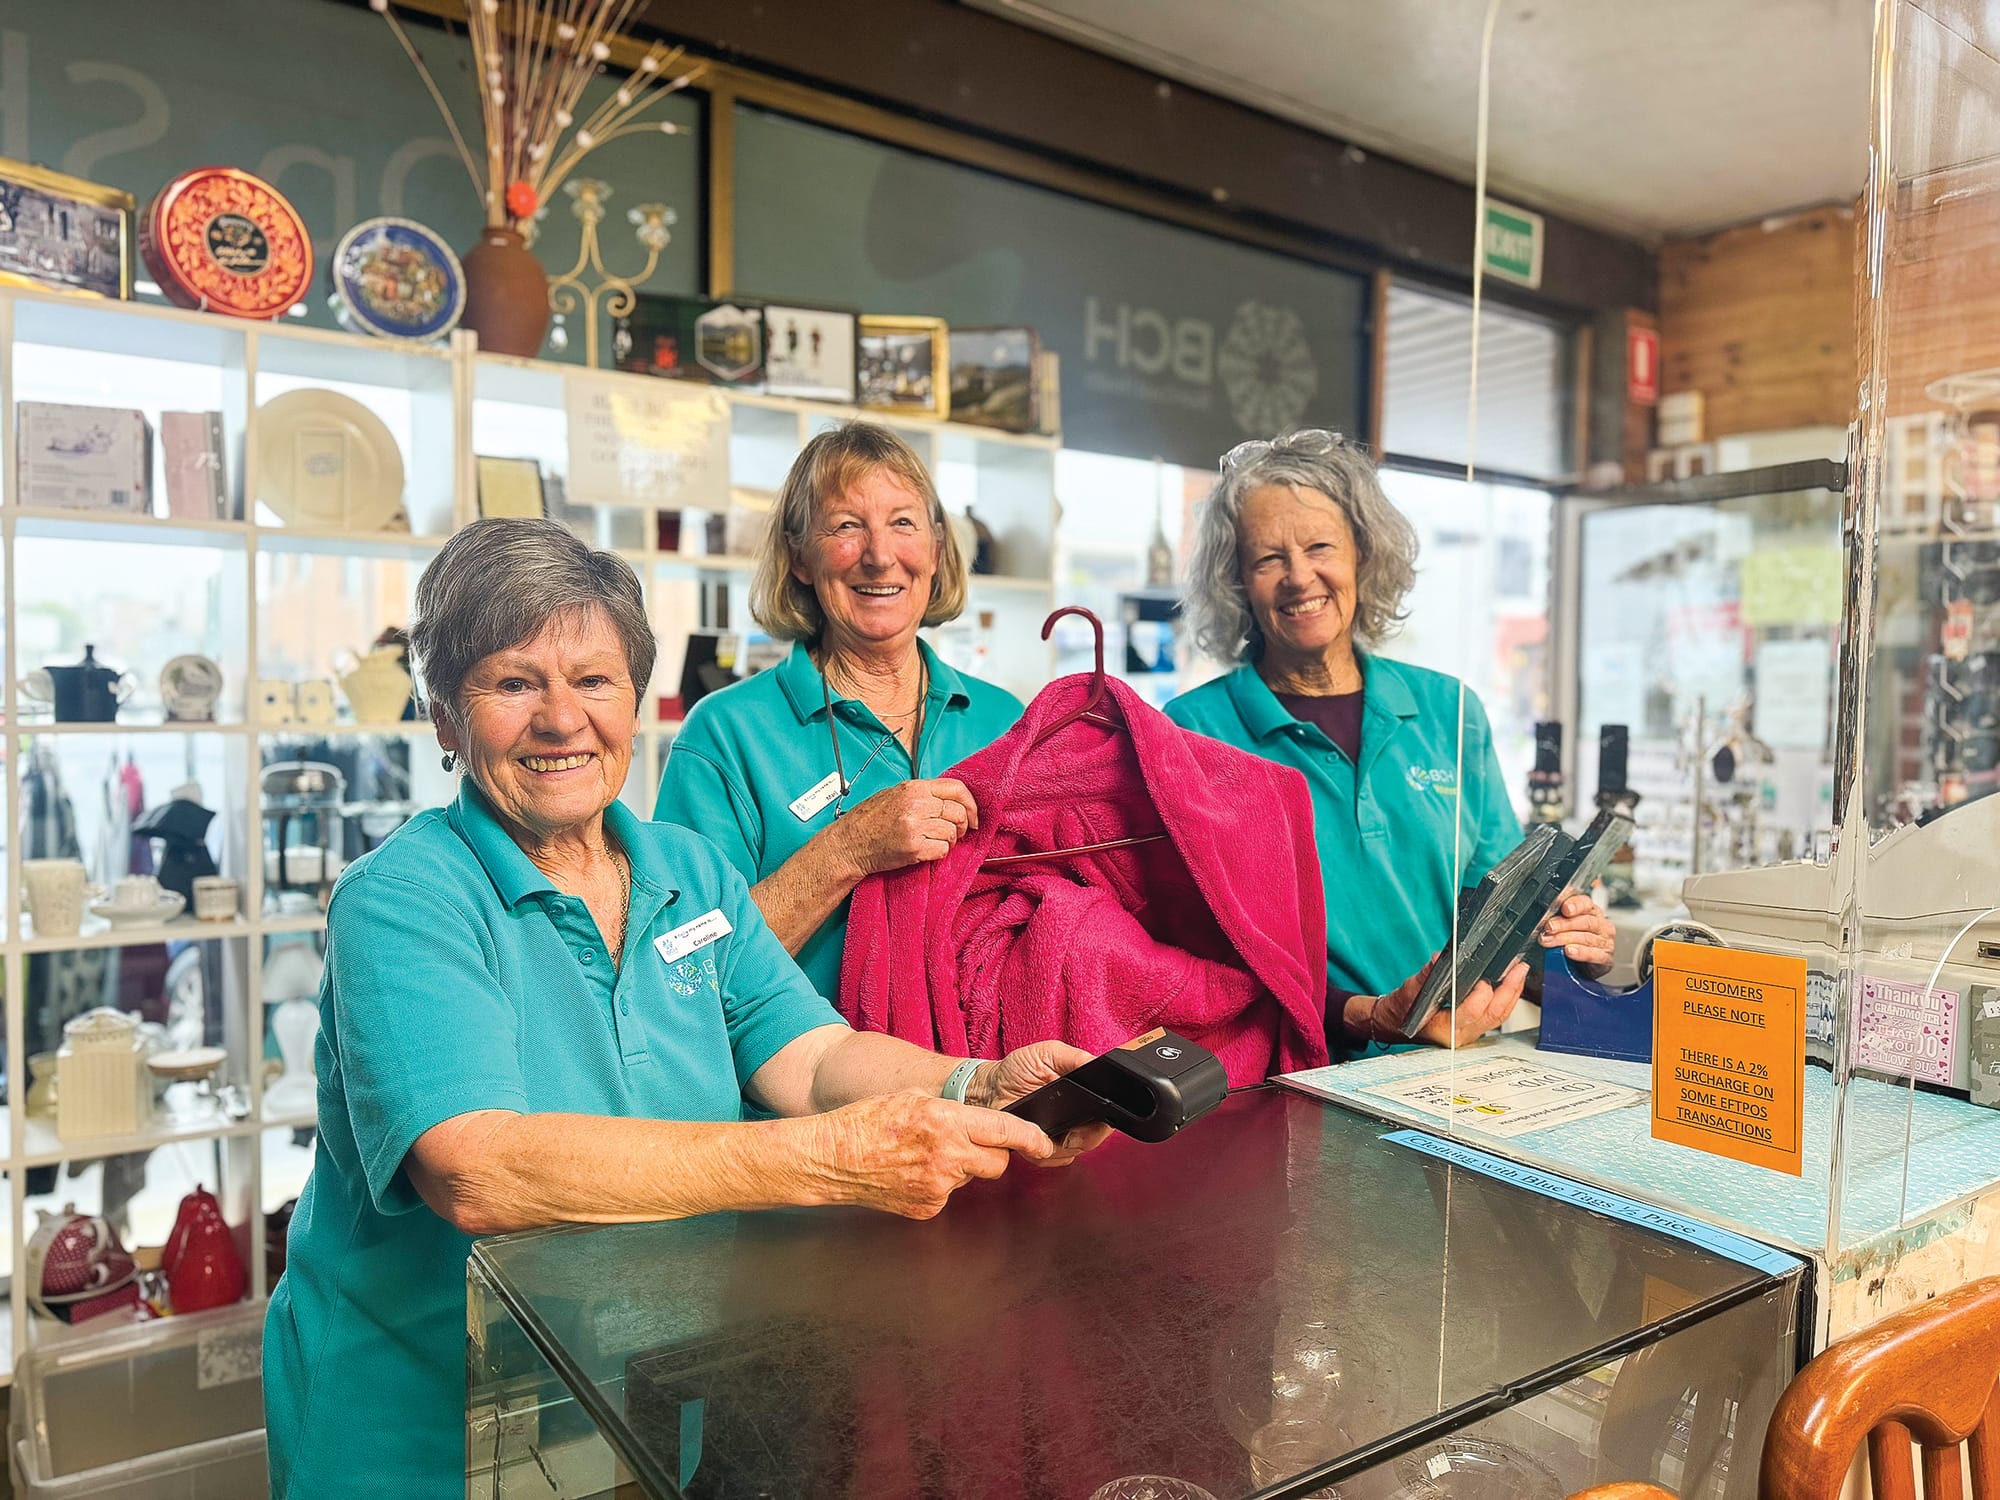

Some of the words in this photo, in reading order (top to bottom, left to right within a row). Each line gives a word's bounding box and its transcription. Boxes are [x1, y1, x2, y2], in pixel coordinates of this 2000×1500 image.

[692, 931, 719, 947] Caroline
[1685, 977, 1763, 1001] CUSTOMERS
[1876, 984, 1917, 1007] Thank
[1684, 1001, 1726, 1019] PLEASE
[1730, 1009, 1765, 1026] NOTE
[1874, 1002, 1940, 1027] GRANDMOHER
[1680, 1048, 1719, 1066] THERE
[1722, 1057, 1734, 1069] IS
[1736, 1060, 1746, 1073] A
[1749, 1062, 1768, 1077] 2%
[1466, 1067, 1537, 1084] Records
[1508, 1074, 1568, 1088] DVDs
[1552, 1082, 1596, 1094] CDs
[1675, 1067, 1750, 1094] SURCHARGE
[1753, 1084, 1774, 1099] ON
[1680, 1088, 1717, 1106] SOME
[1720, 1096, 1768, 1118] EFTPOS
[1676, 1106, 1772, 1140] TRANSACTIONS
[1409, 1135, 1478, 1164] Clothing
[1481, 1160, 1518, 1179] with
[1522, 1174, 1565, 1193] Blue
[1571, 1189, 1616, 1210] Tags
[1642, 1212, 1696, 1235] Price
